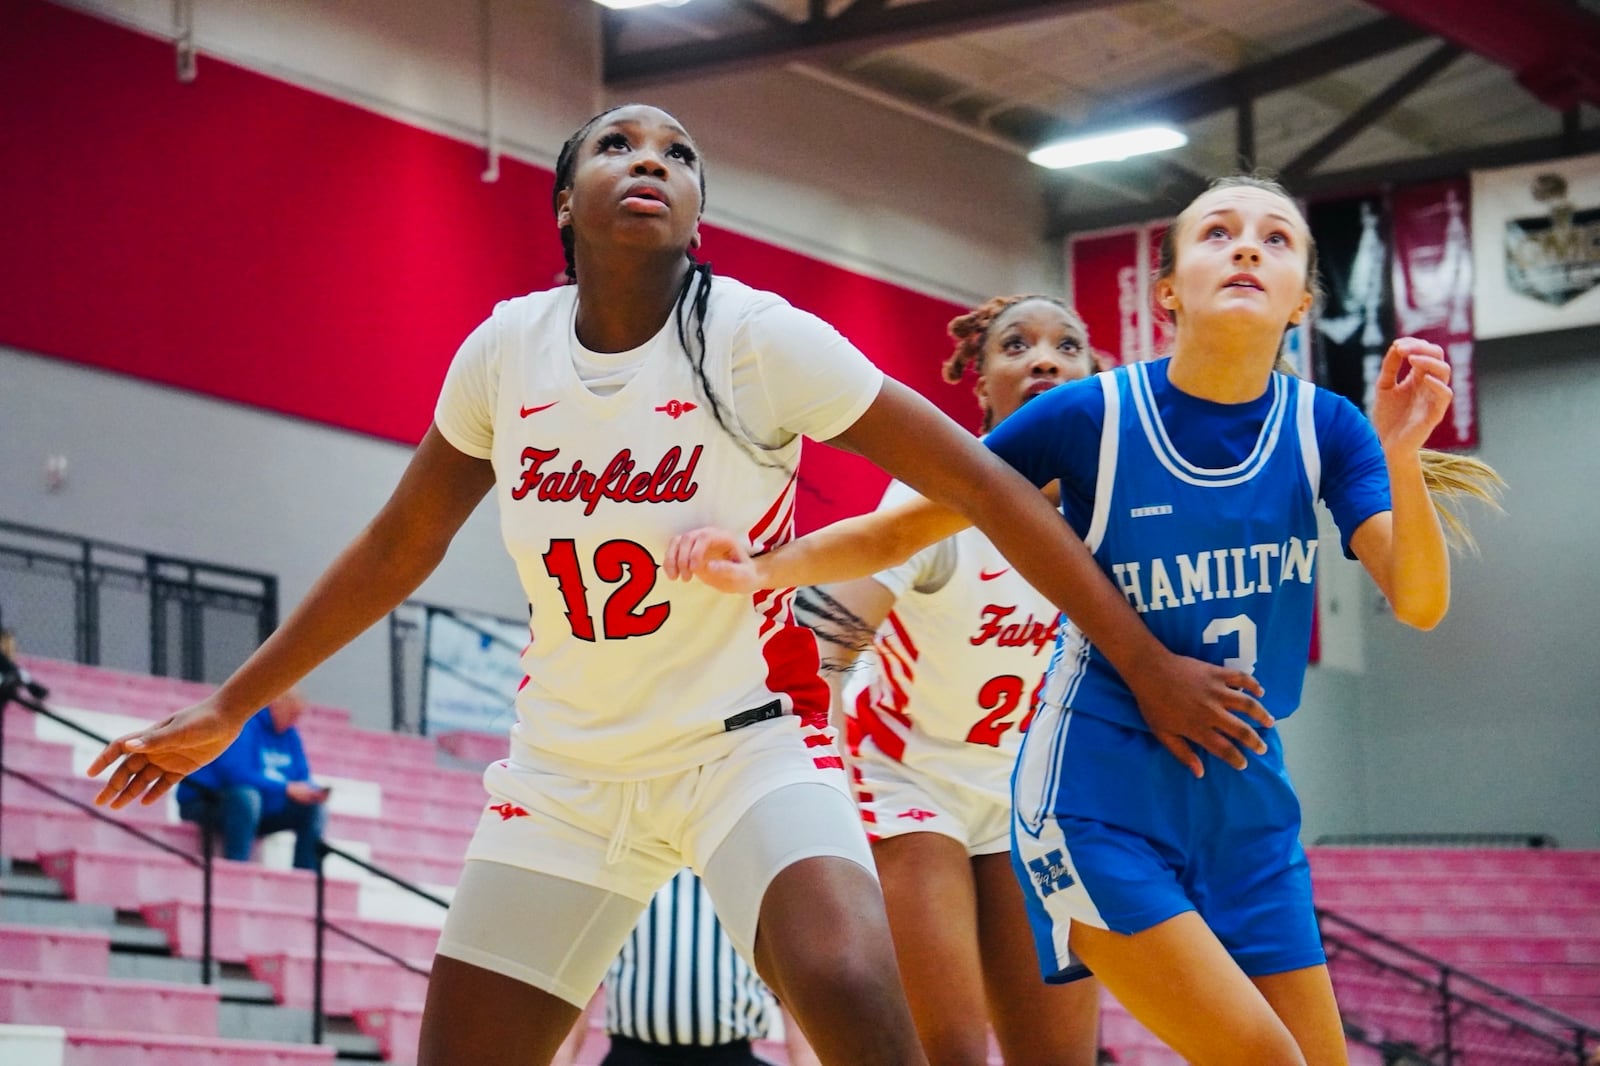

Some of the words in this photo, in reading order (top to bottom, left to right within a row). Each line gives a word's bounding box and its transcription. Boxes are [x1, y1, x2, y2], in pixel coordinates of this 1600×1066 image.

[511, 445, 704, 516] Fairfield
[542, 538, 671, 642] 12
[1112, 536, 1319, 613] HAMILTN
